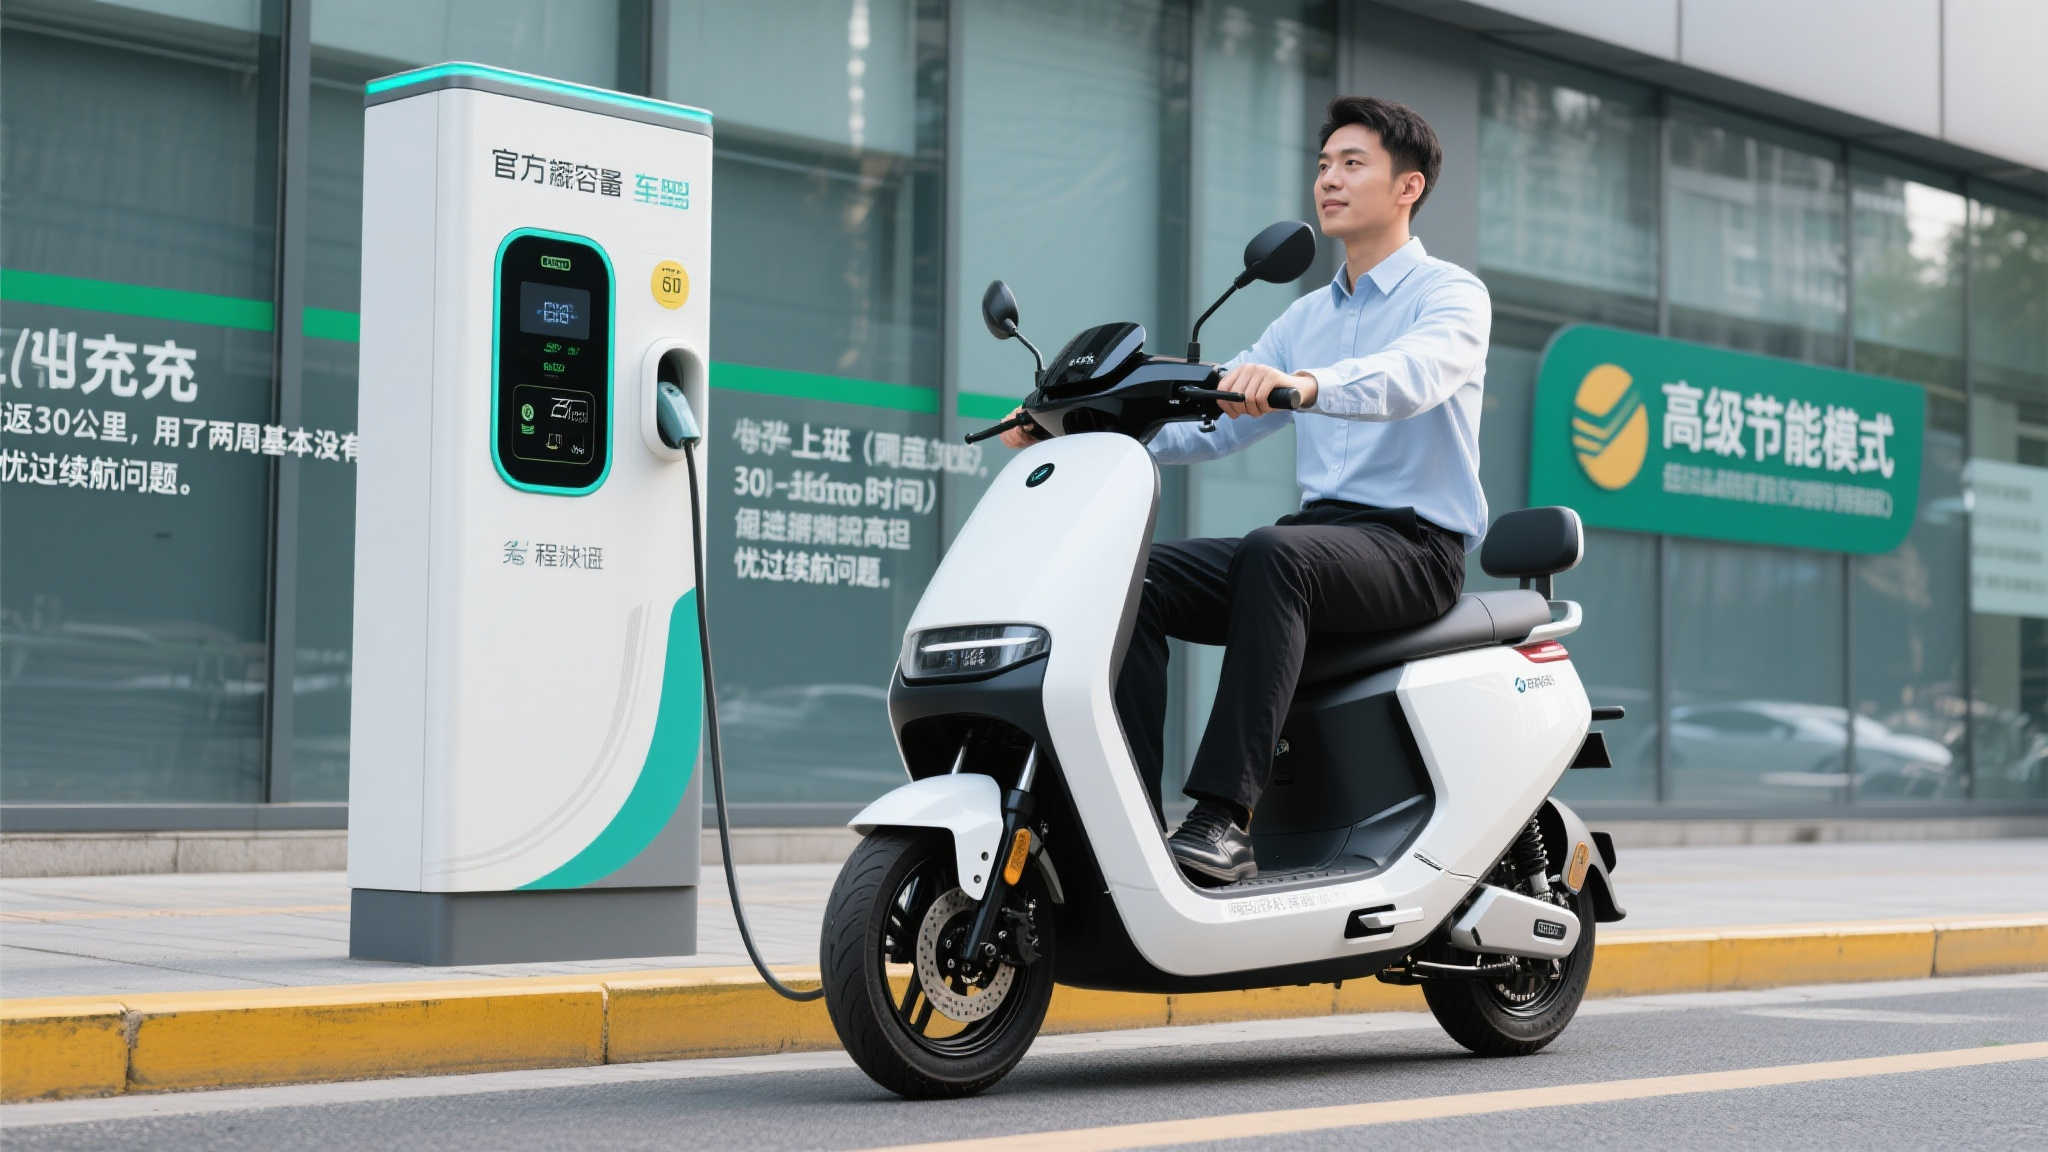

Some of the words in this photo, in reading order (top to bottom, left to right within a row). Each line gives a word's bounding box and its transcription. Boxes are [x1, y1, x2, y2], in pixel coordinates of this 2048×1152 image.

[0, 400, 360, 464] 返30公里，用了两周基本没有
[1661, 379, 1896, 479] 高级节能模式
